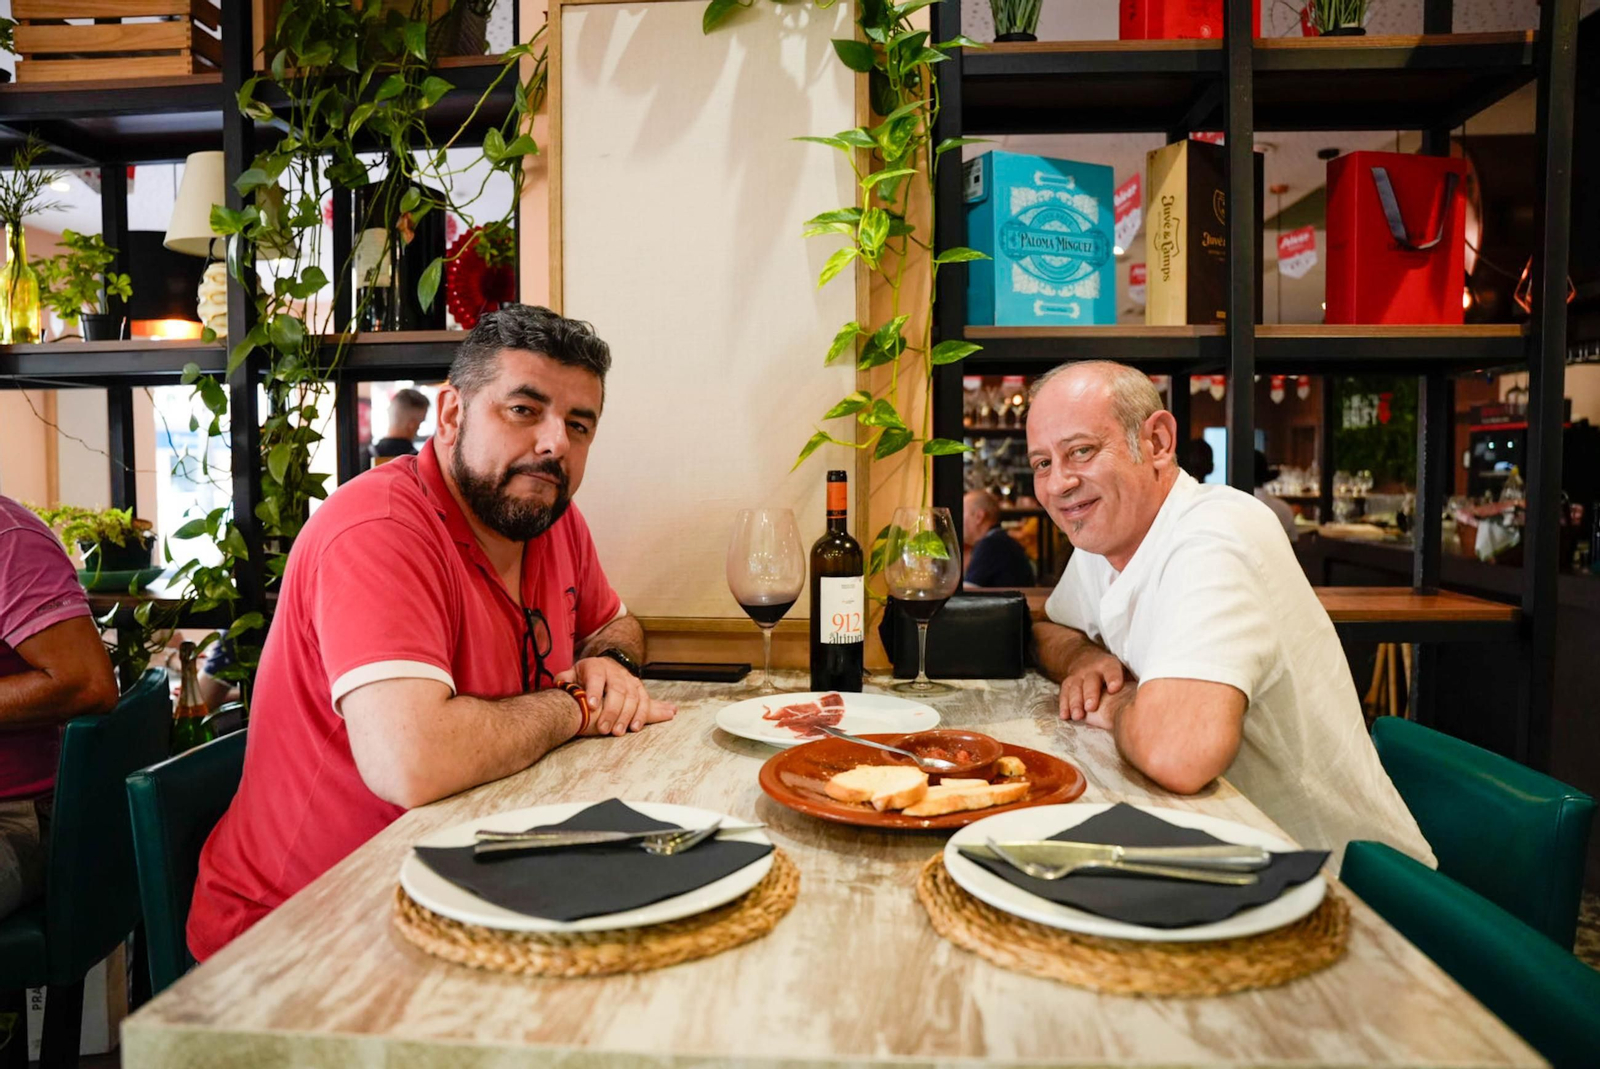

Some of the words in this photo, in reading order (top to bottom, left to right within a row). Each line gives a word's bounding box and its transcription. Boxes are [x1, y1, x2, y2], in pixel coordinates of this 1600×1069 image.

[1020, 232, 1054, 249] PALOMA
[1161, 241, 1175, 282] Camps
[832, 612, 861, 633] 912
